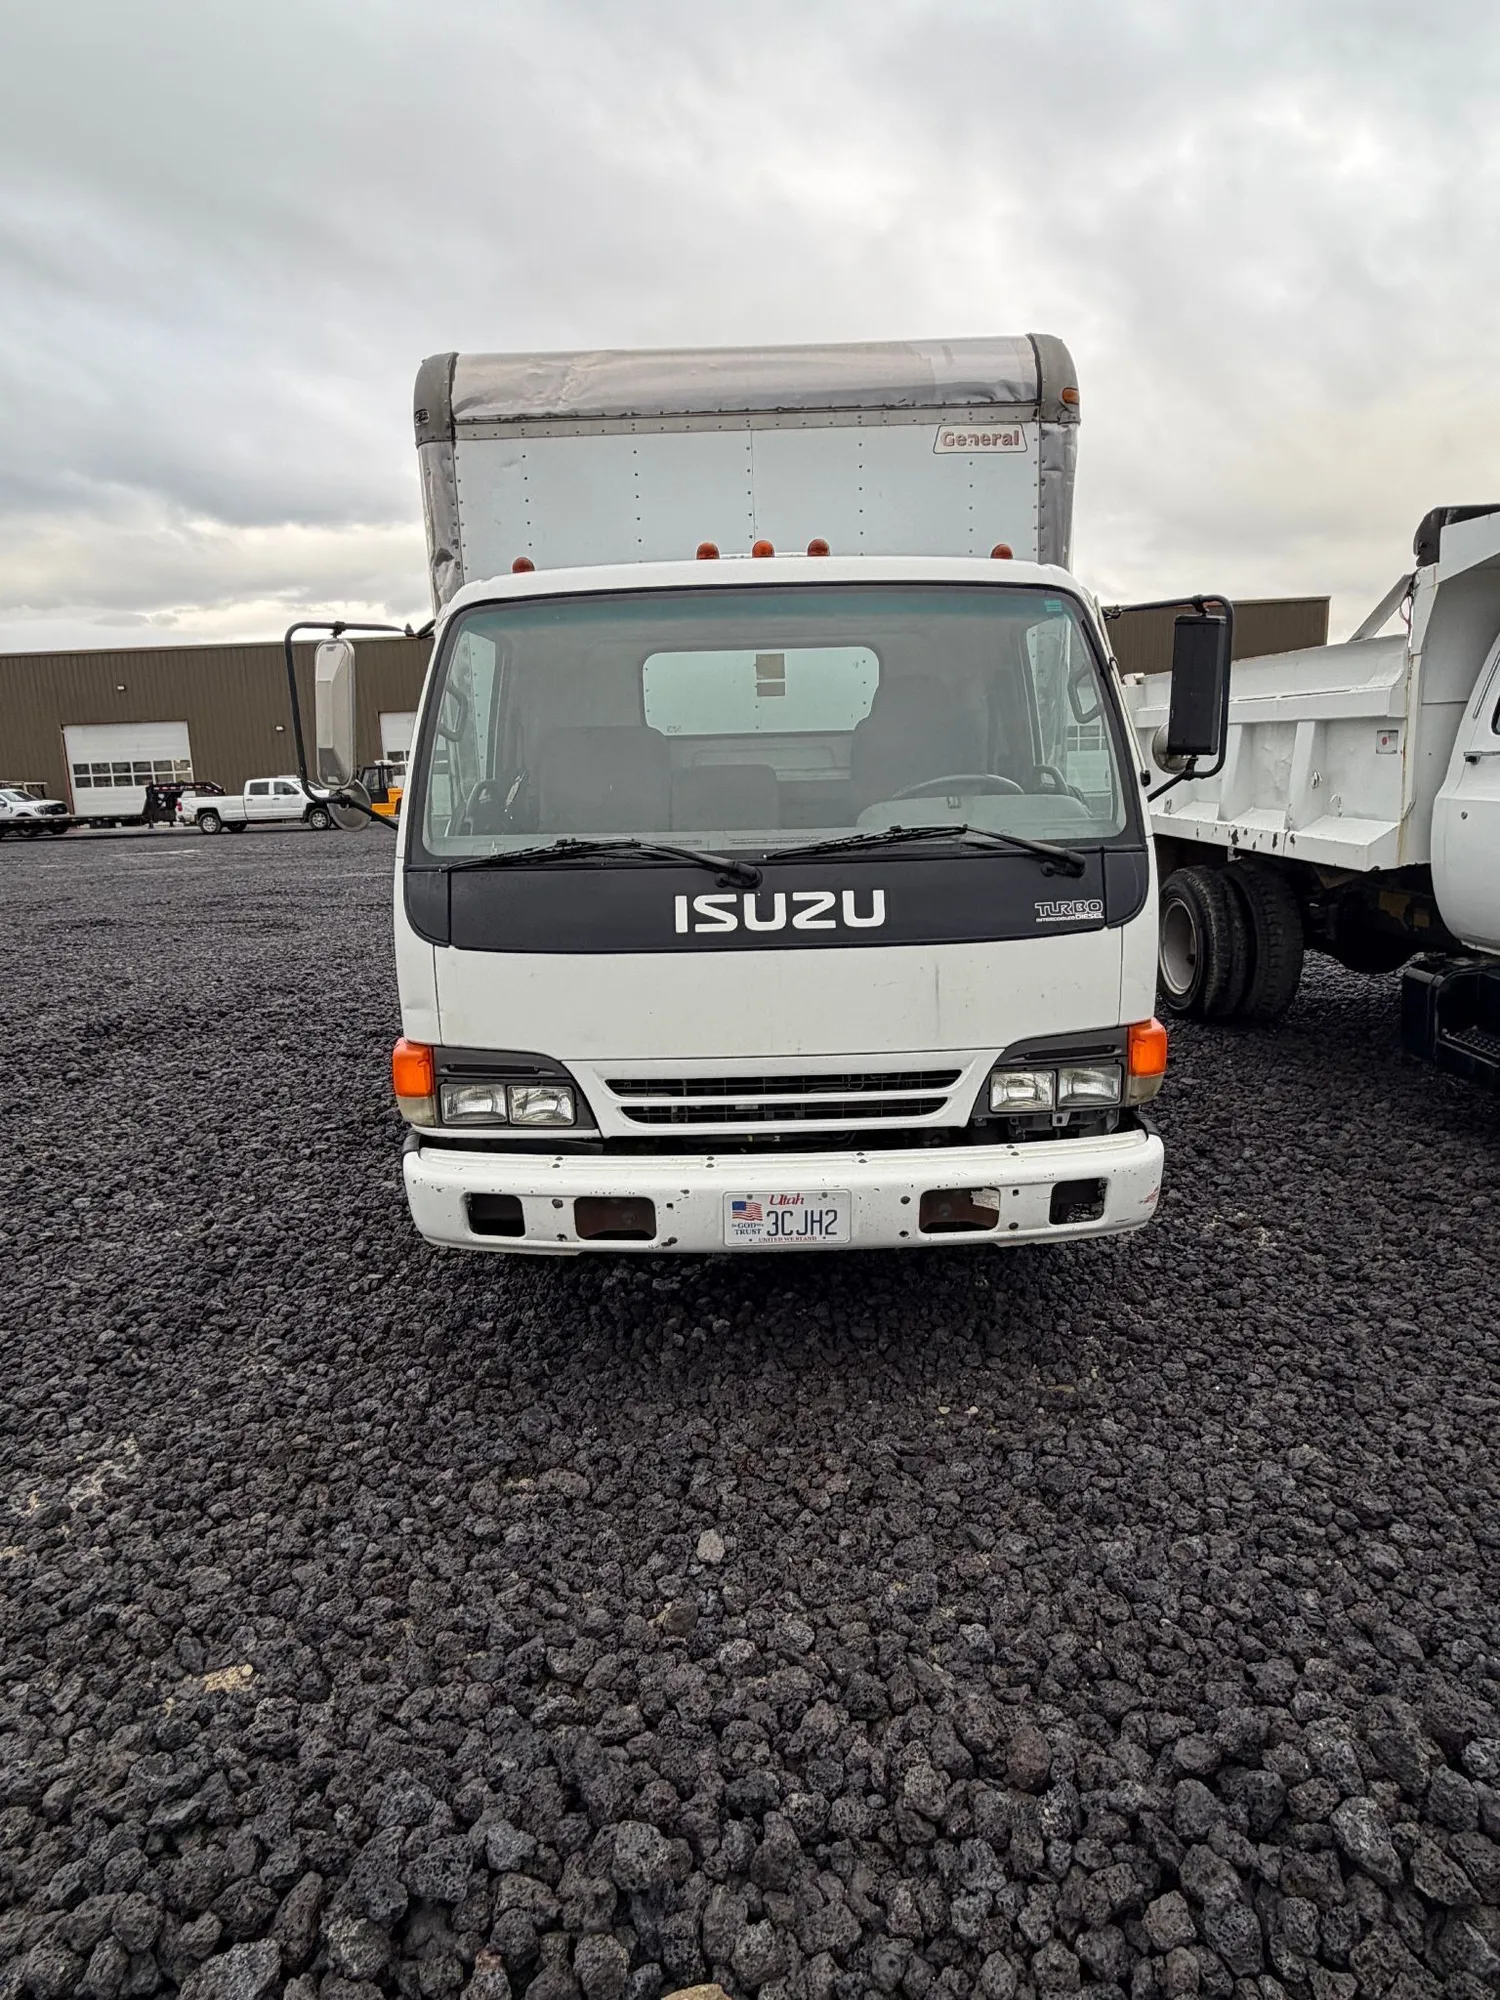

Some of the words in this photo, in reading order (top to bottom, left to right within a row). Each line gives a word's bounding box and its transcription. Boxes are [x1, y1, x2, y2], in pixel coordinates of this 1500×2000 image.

[941, 430, 1020, 447] General
[674, 889, 886, 934] ISUZU
[1034, 899, 1104, 917] TURBO
[769, 1192, 805, 1206] Utah
[766, 1209, 838, 1237] 3CJH2
